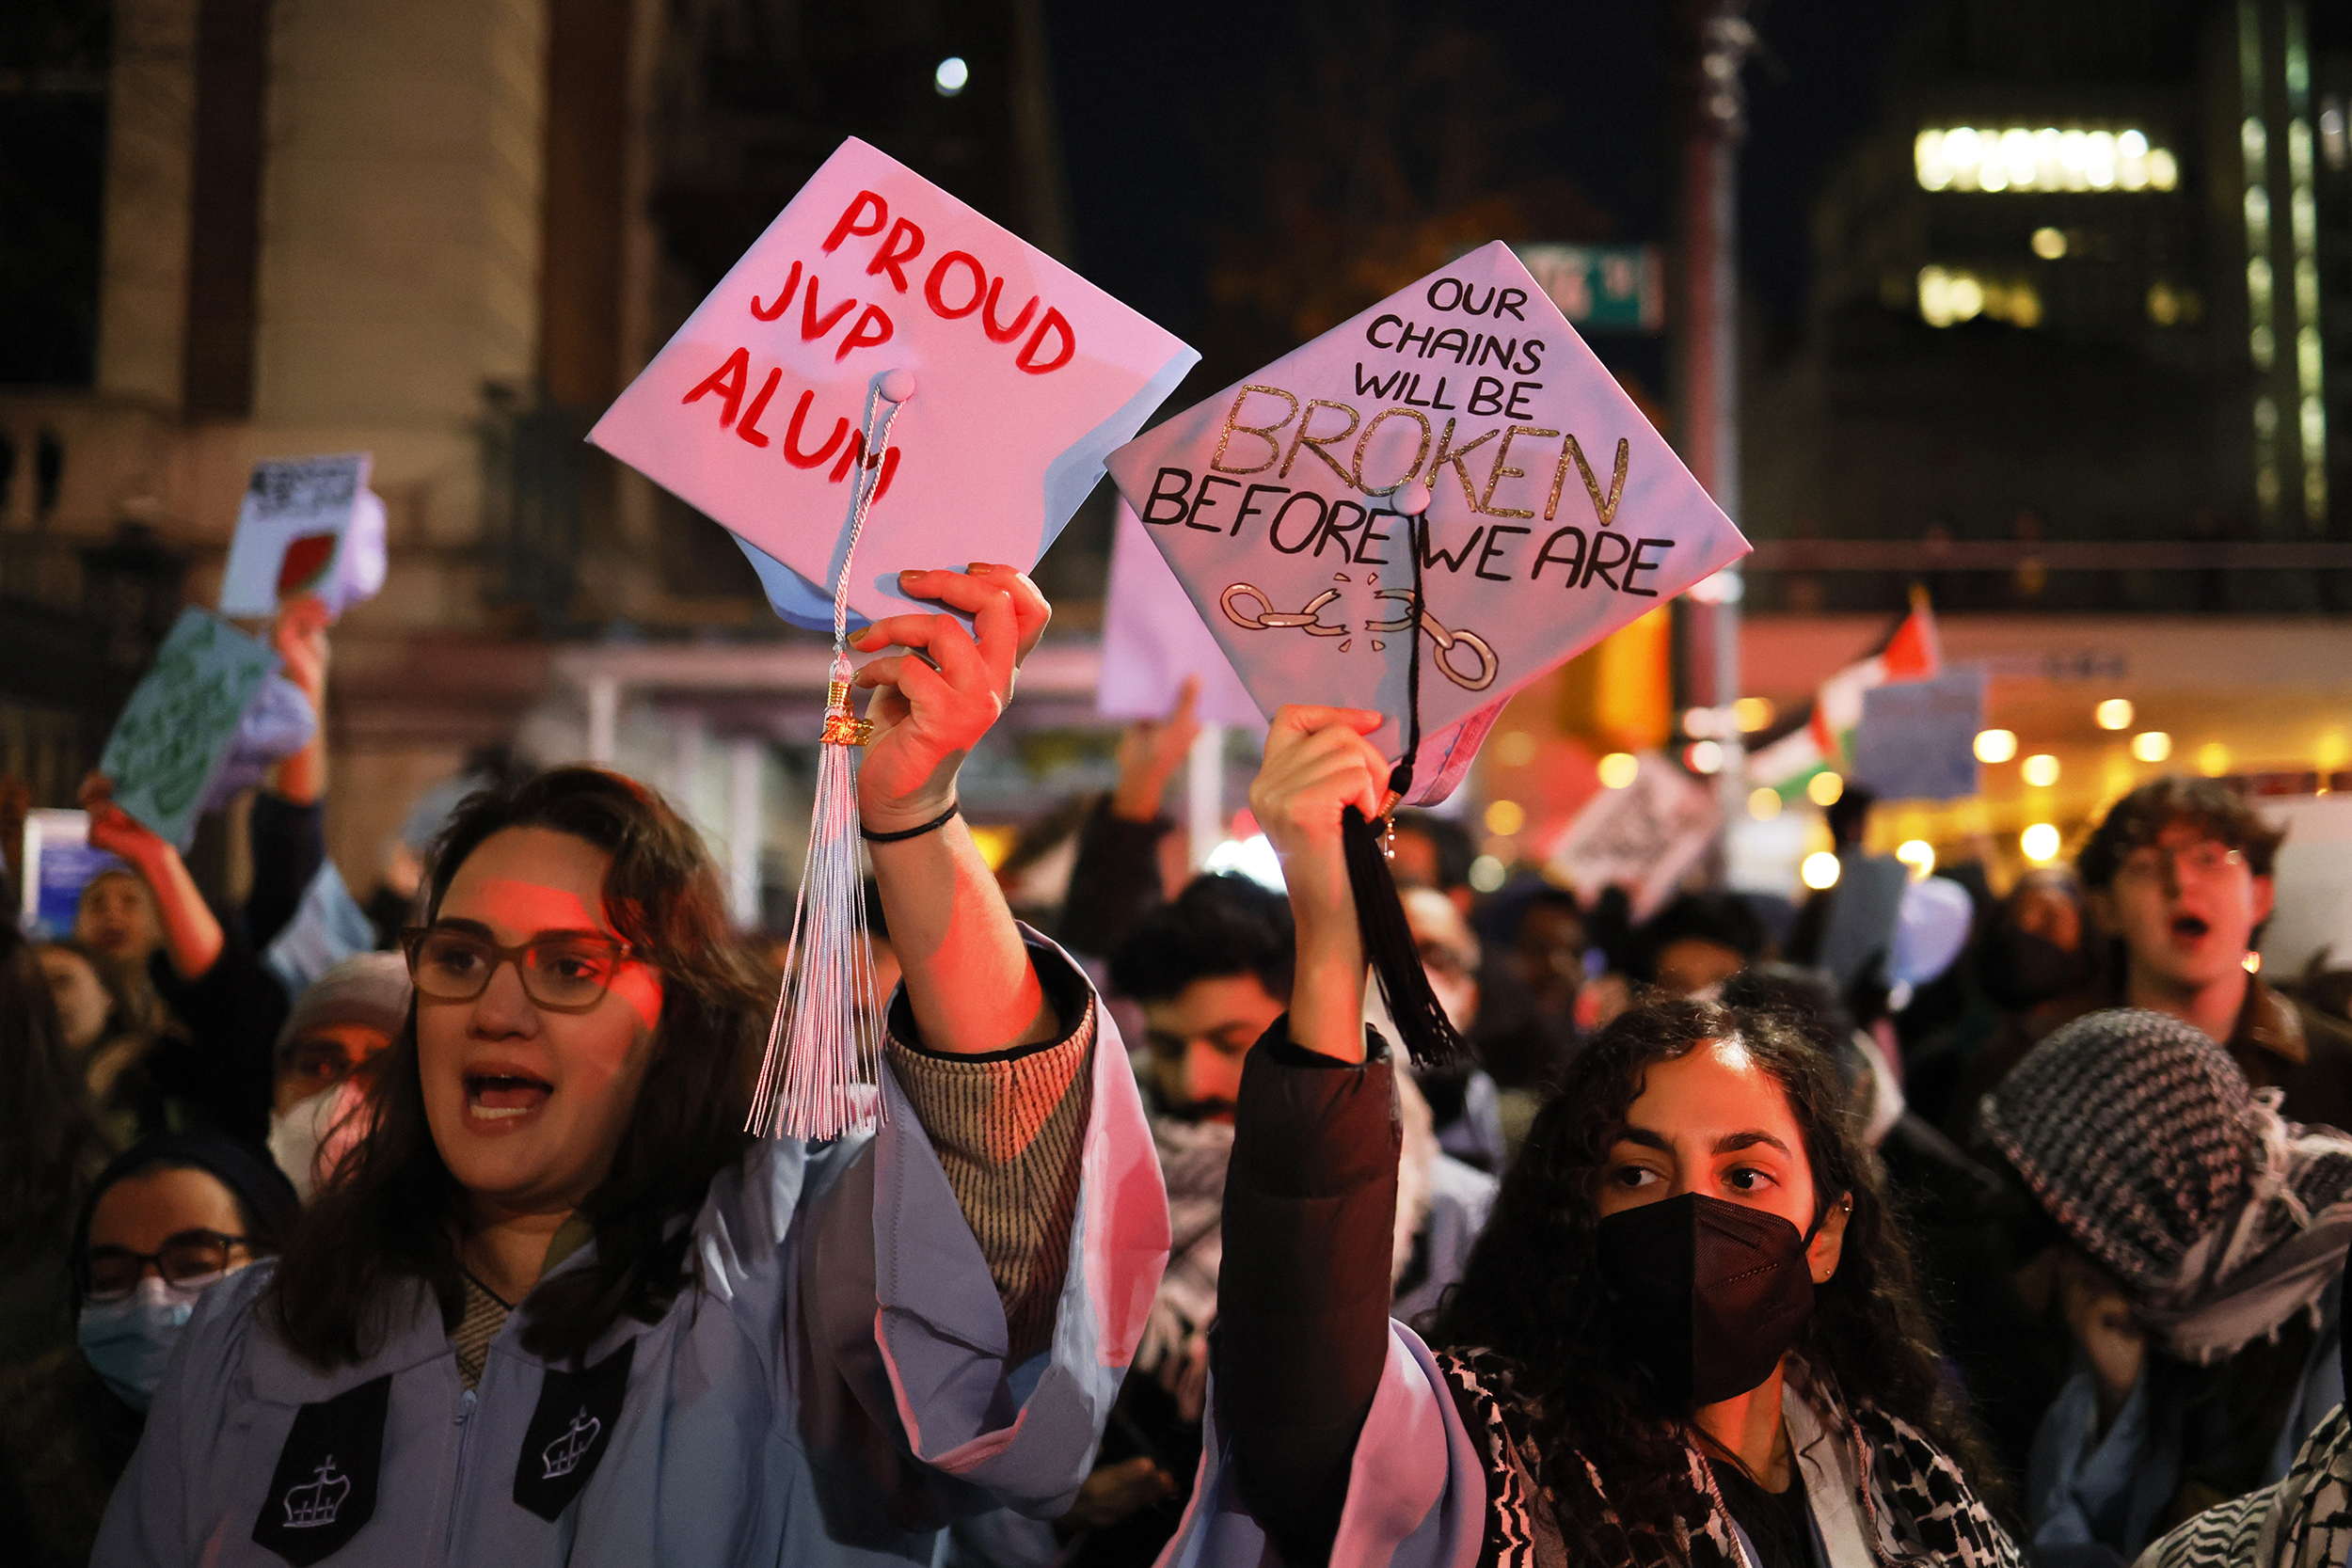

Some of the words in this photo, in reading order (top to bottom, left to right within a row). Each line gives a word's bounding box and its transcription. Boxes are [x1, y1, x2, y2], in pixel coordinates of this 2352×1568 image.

[750, 260, 894, 364] JVP
[821, 190, 1076, 375] PROUD
[1426, 277, 1528, 322] OUR
[1355, 362, 1456, 410] WILL
[1468, 376, 1544, 420] BE
[1366, 313, 1546, 375] CHAINS
[681, 346, 901, 505] ALUM
[1210, 384, 1629, 527] BROKEN
[1142, 467, 1399, 566] BEFORE
[1421, 517, 1532, 582] WE
[1532, 526, 1677, 597] ARE
